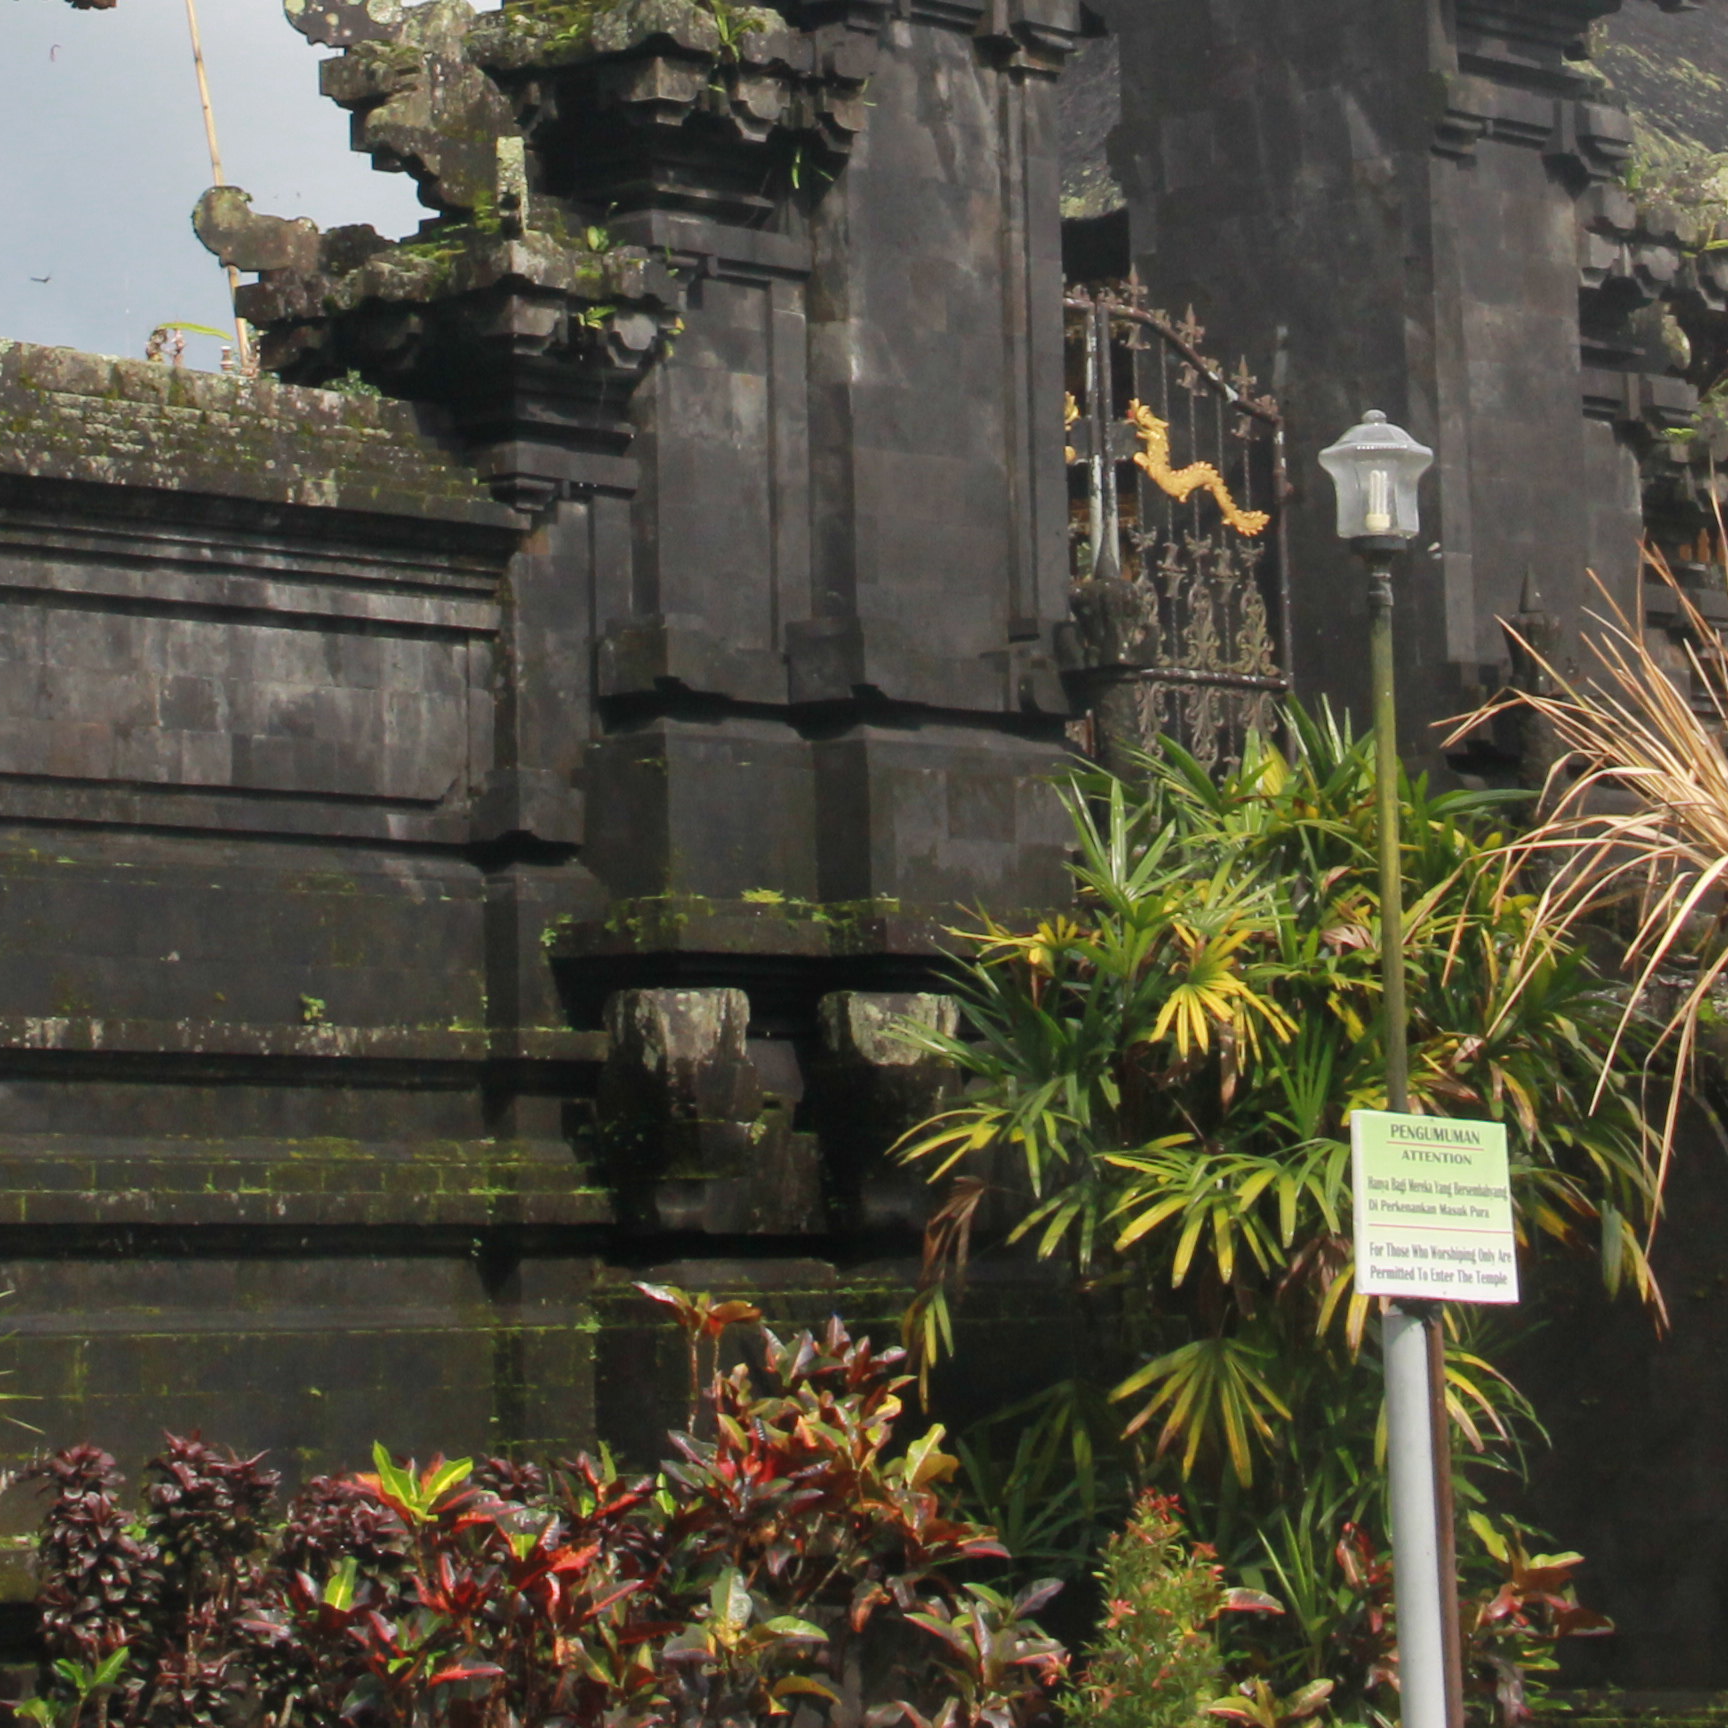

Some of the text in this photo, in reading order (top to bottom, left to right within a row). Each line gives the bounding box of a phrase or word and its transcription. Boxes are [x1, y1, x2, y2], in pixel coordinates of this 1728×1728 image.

[1390, 1124, 1481, 1145] PENGUMUMAN
[1402, 1150, 1473, 1165] ATTENTION
[1392, 1178, 1406, 1194] Bagi
[1435, 1181, 1453, 1198] Yang
[1369, 1199, 1378, 1211] Di
[1439, 1204, 1467, 1217] Masuk
[1471, 1206, 1490, 1218] Pura
[1370, 1242, 1384, 1257] For
[1386, 1243, 1410, 1258] Those
[1412, 1244, 1429, 1259] Who
[1479, 1249, 1495, 1265] Only
[1498, 1250, 1512, 1263] Are
[1371, 1265, 1508, 1287] Permitted To Enter The Temple
